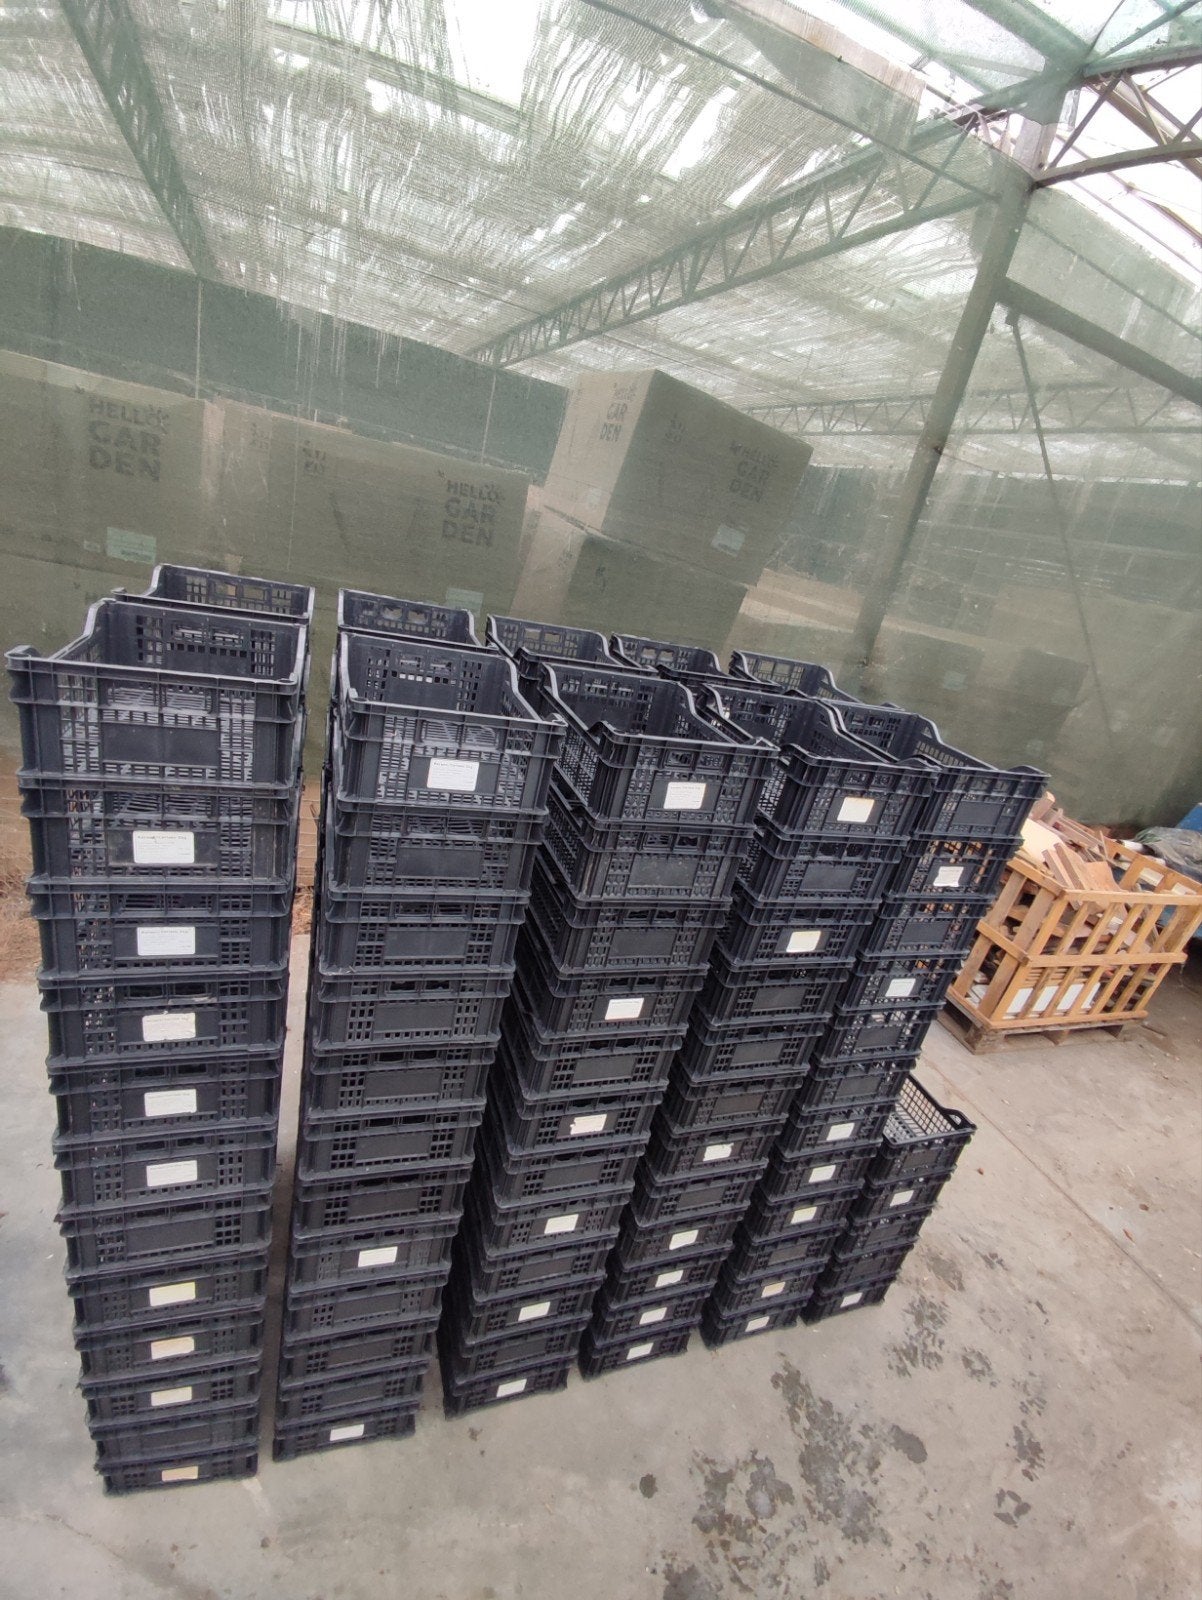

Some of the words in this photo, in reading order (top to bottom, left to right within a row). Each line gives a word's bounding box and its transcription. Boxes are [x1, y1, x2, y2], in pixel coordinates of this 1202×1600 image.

[599, 422, 623, 442] DEN
[89, 445, 161, 482] DEN
[441, 519, 495, 547] DEN
